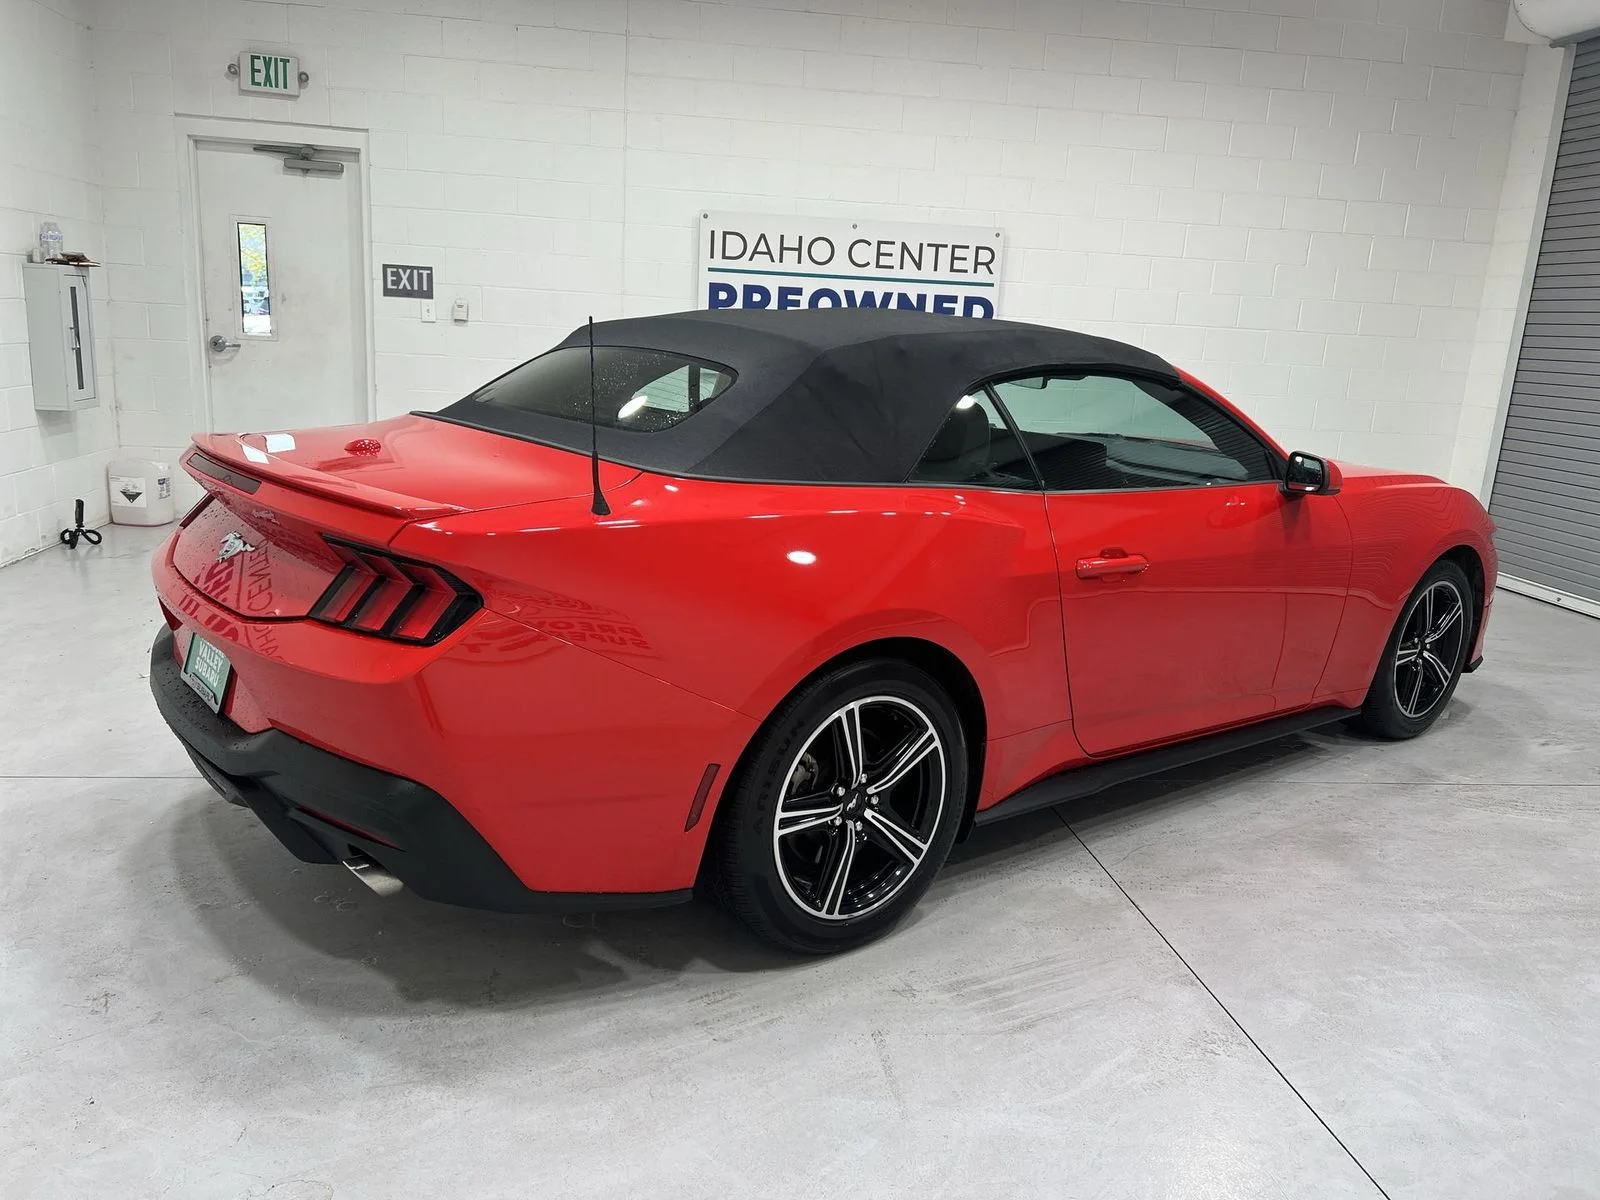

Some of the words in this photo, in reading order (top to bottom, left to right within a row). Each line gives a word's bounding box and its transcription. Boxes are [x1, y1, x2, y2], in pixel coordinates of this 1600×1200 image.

[250, 54, 290, 90] EXIT
[709, 229, 836, 266] IDAHO
[847, 238, 996, 275] CENTER
[386, 267, 431, 291] EXIT
[708, 282, 994, 320] PREOWNED
[195, 656, 220, 688] SUBARU
[199, 640, 223, 673] VALLEY
